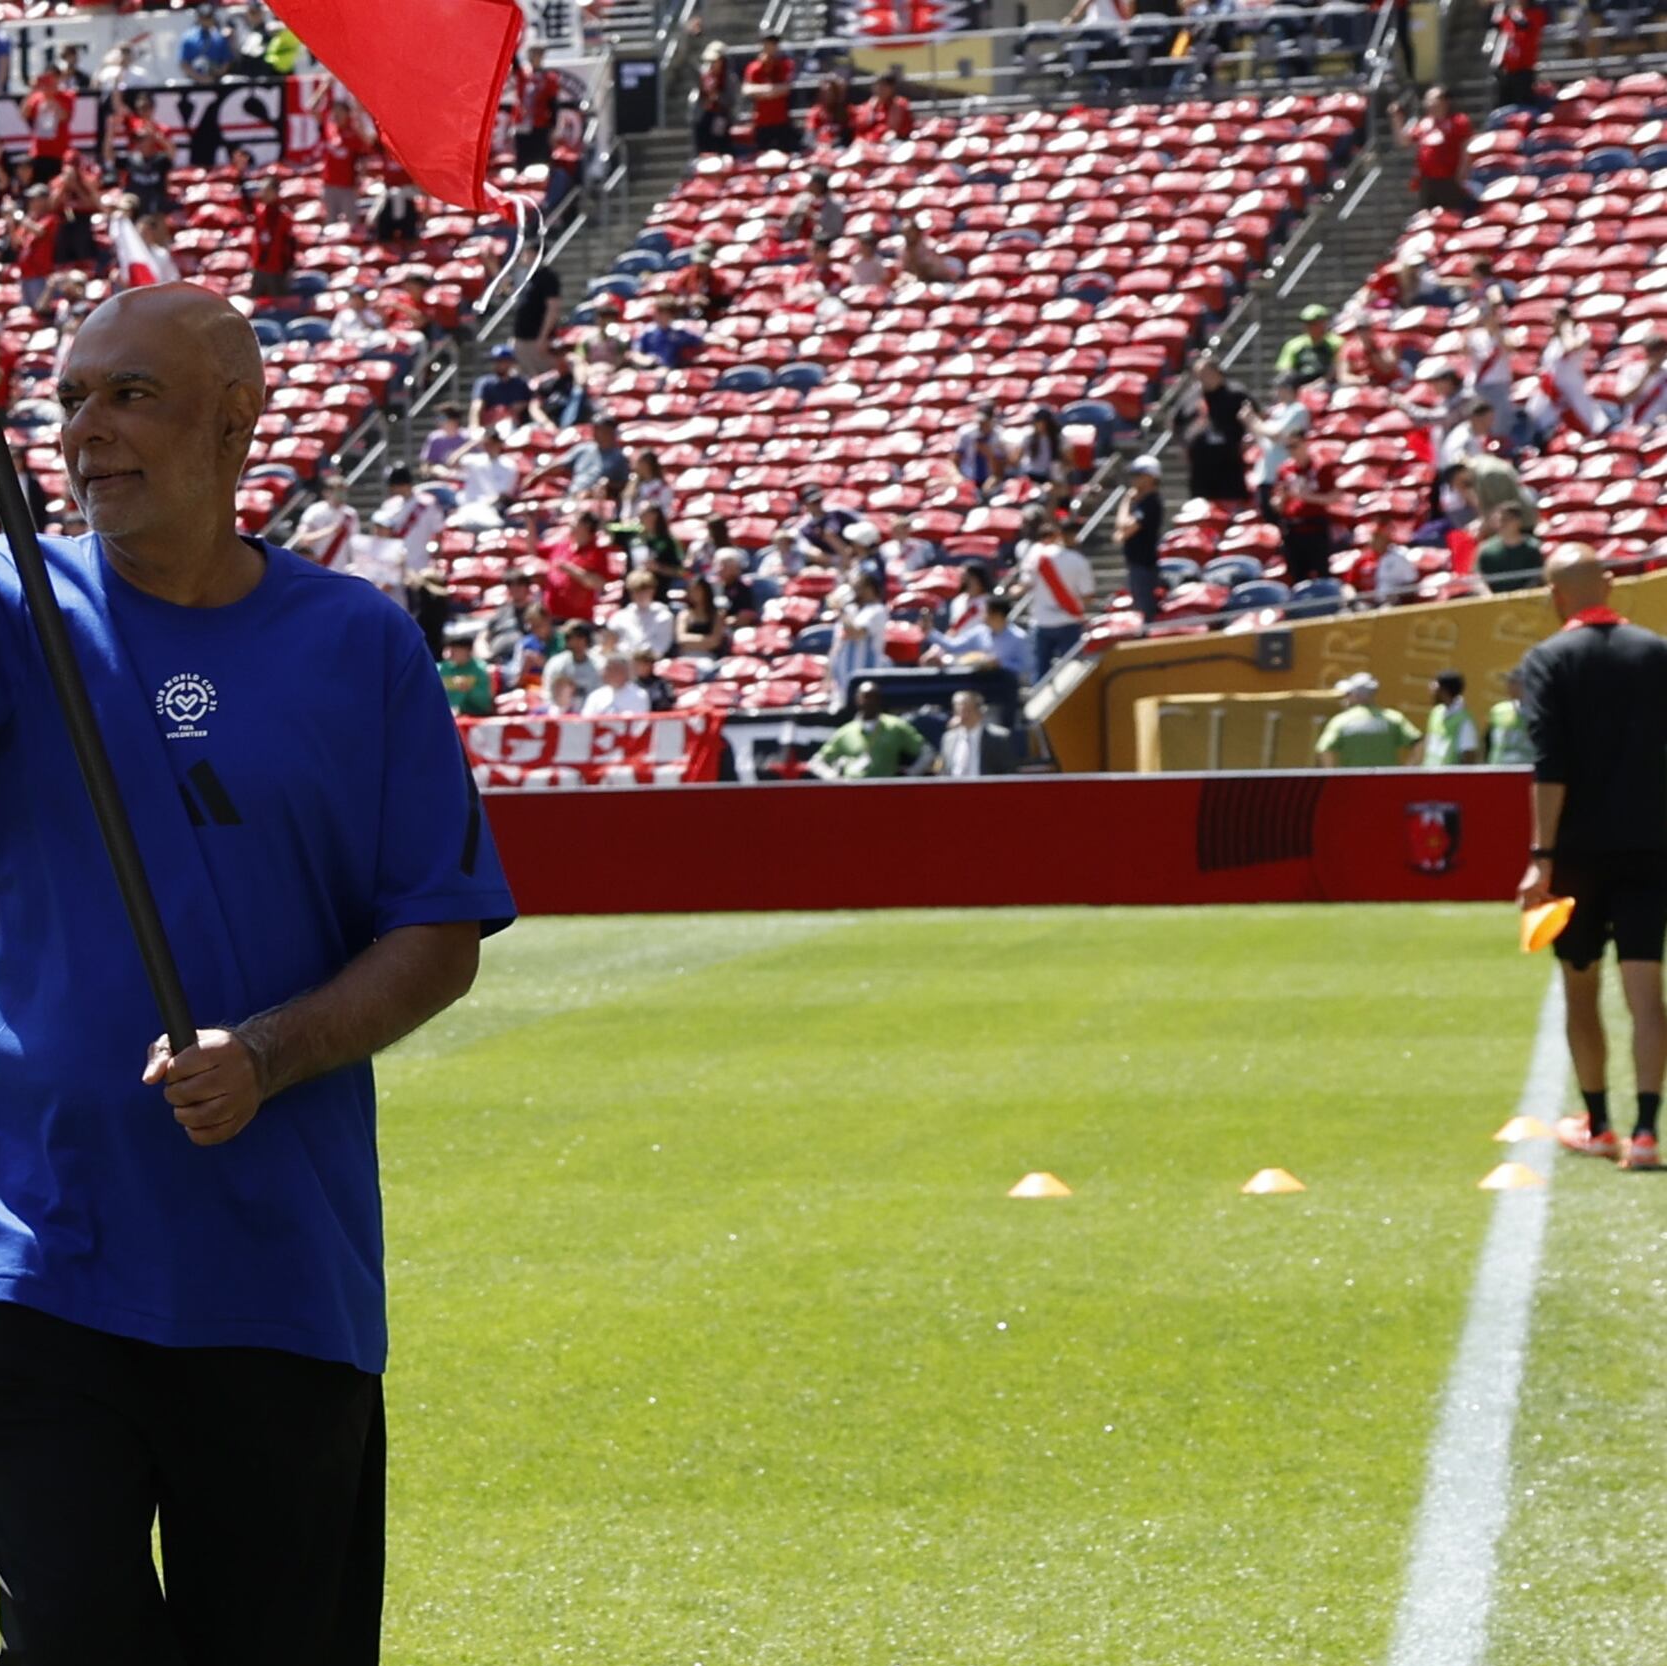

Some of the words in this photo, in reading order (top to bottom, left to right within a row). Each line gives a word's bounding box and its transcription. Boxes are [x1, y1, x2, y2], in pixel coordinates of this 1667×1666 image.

[164, 673, 200, 688] WORLD
[202, 679, 216, 696] CUP
[468, 718, 705, 766] GET
